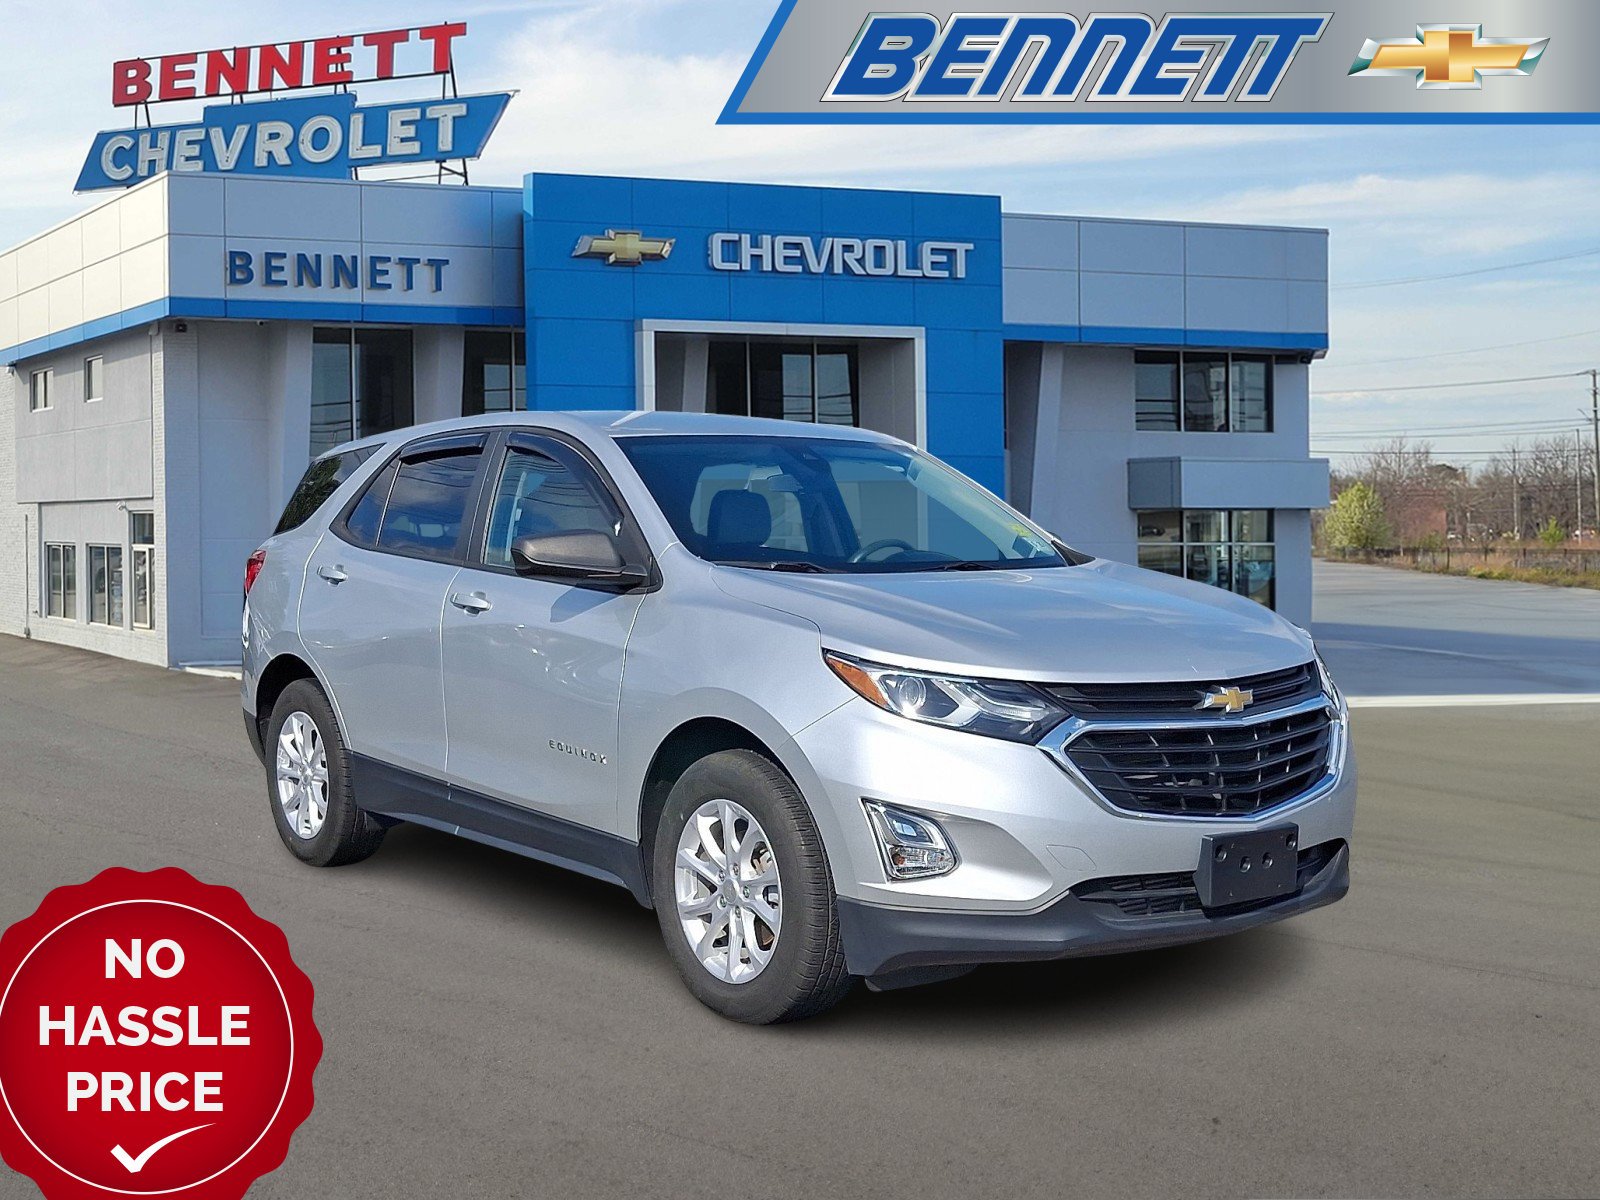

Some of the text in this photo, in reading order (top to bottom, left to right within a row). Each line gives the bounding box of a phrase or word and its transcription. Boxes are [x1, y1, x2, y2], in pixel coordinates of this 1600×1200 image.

[112, 23, 467, 107] BENNETT
[100, 103, 468, 181] CHEVROLET
[226, 250, 450, 292] BENNETT
[708, 232, 974, 279] CHEVROLET
[548, 739, 607, 766] EQUINOX
